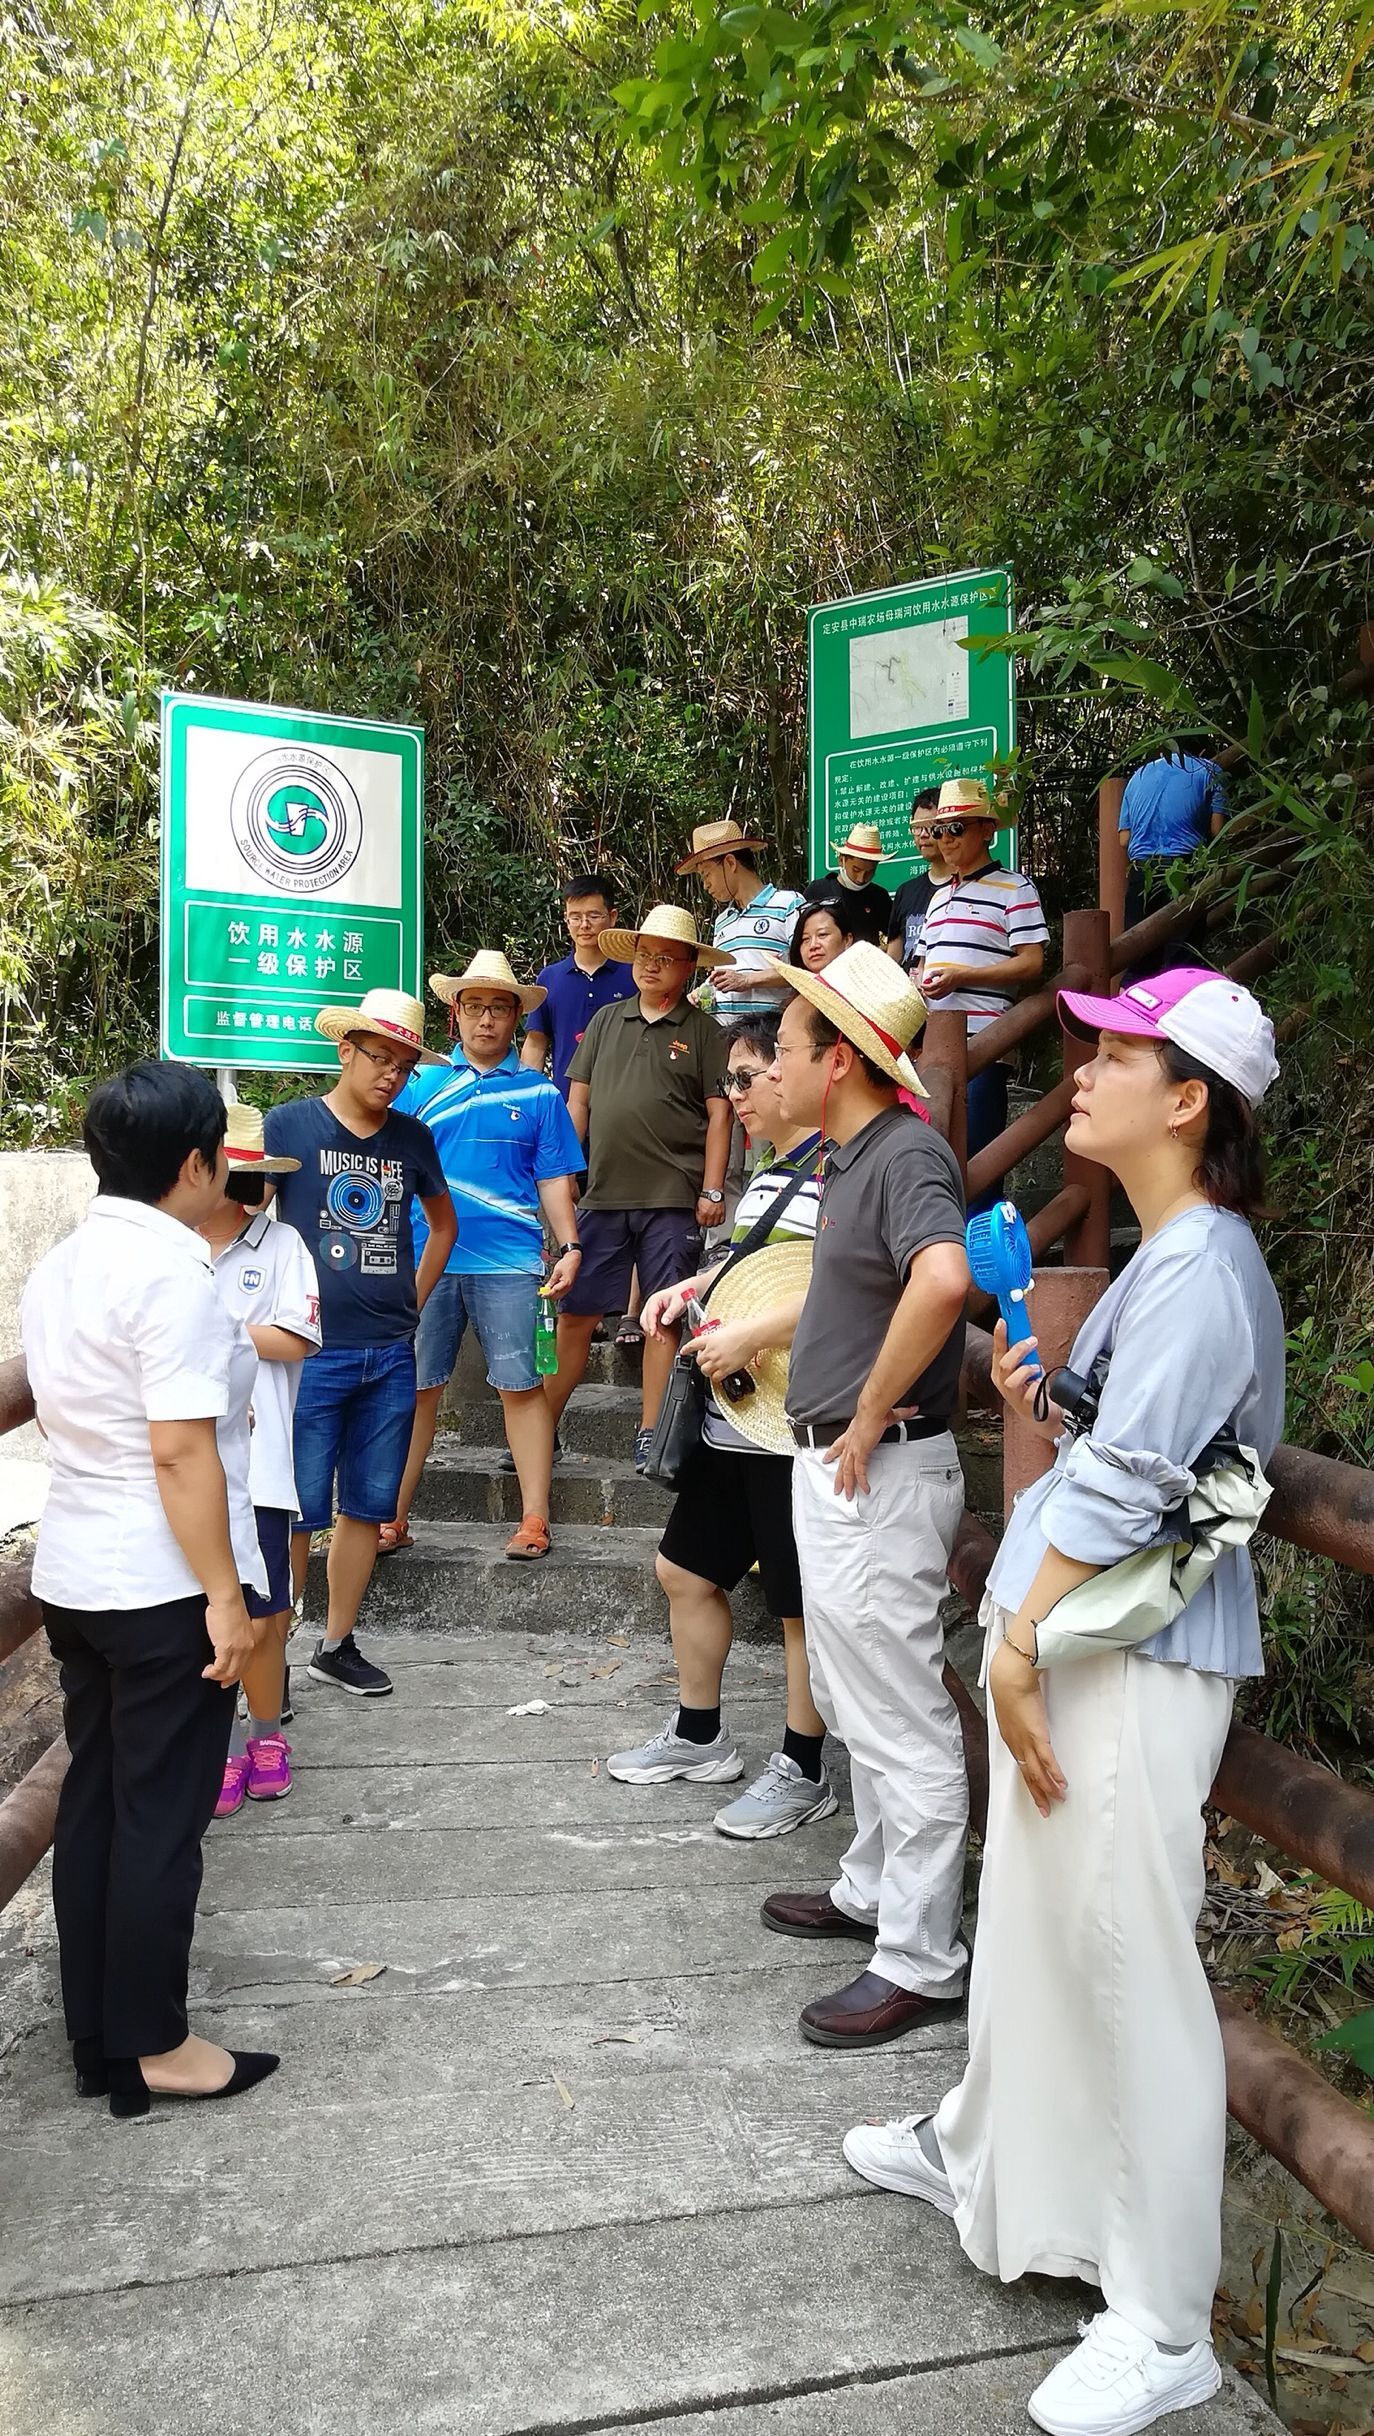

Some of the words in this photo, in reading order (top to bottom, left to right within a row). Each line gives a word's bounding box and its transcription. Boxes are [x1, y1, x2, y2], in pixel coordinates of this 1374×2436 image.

[293, 867, 340, 889] PROTECTION
[338, 849, 354, 871] AREA
[227, 920, 365, 954] 饮用水水源
[227, 950, 364, 981] 一级保护区
[215, 1010, 314, 1032] 监督管理电话
[320, 1149, 363, 1176] MUSIC
[365, 1156, 378, 1174] IS
[381, 1158, 403, 1181] LIFE
